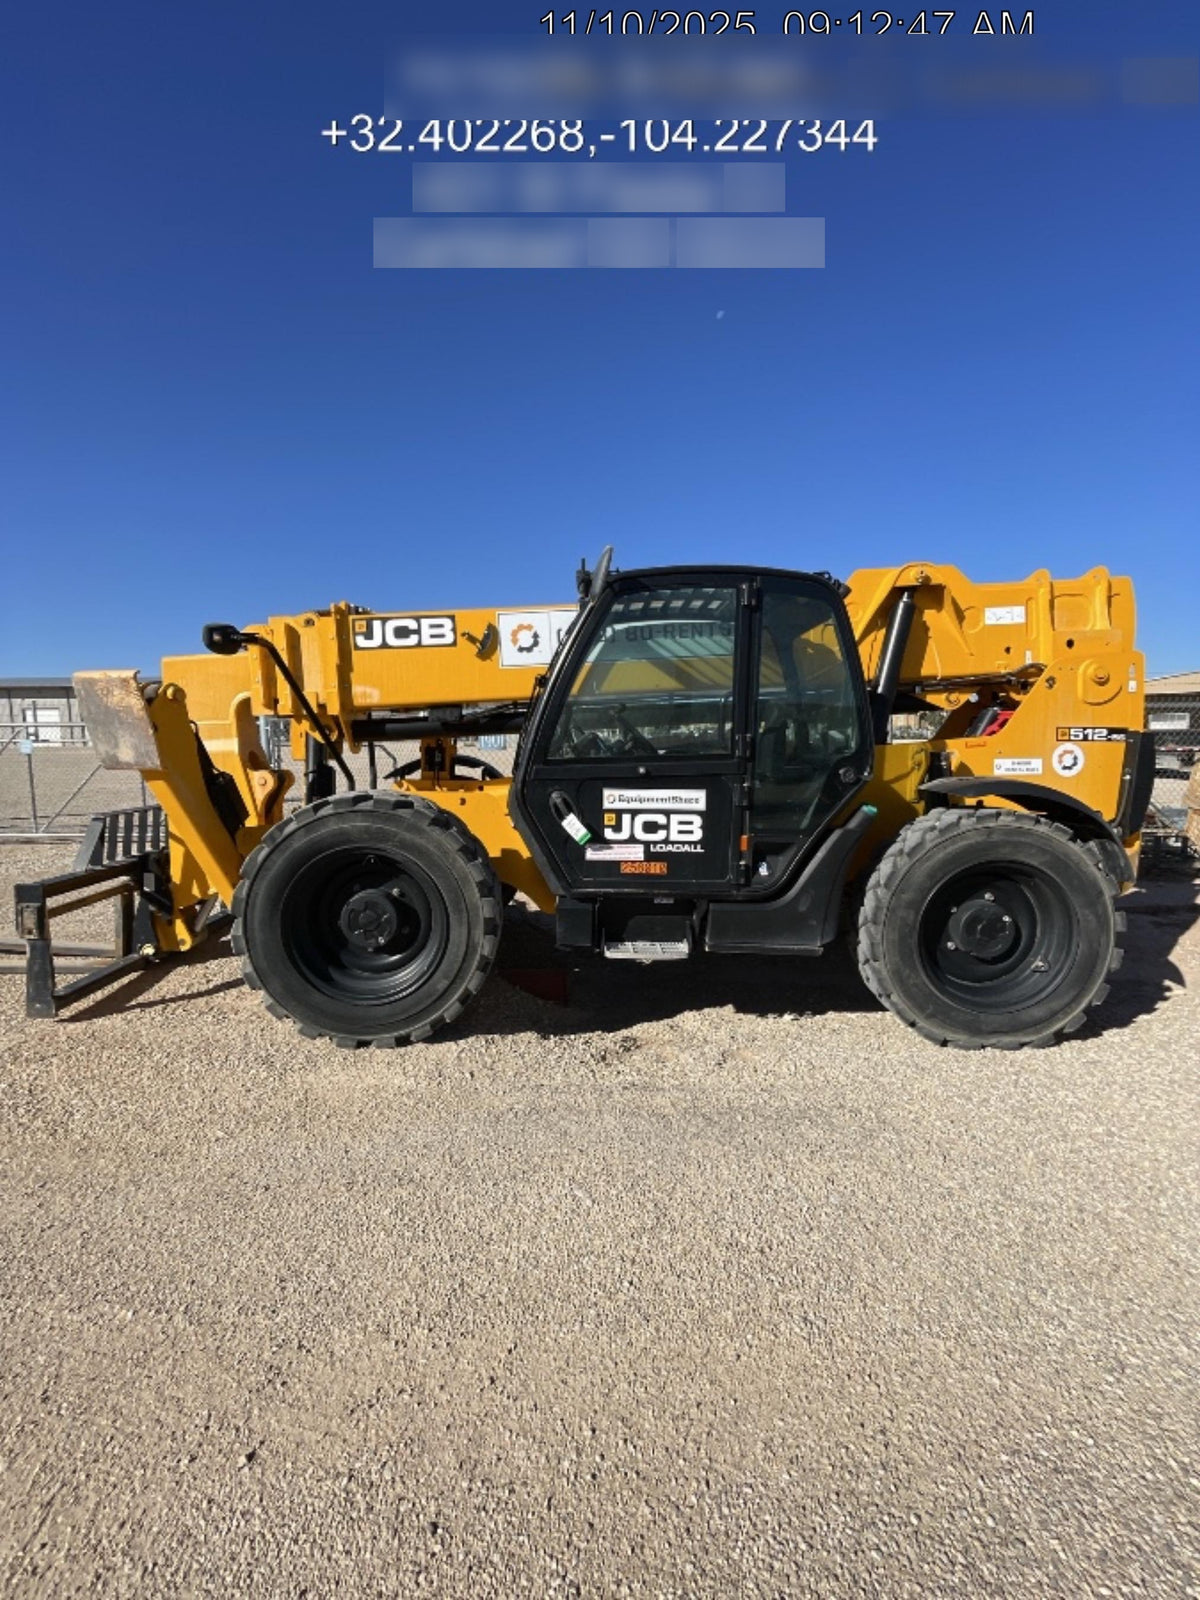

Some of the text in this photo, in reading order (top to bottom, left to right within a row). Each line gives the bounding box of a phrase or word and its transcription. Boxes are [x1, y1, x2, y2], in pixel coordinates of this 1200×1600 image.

[355, 617, 455, 648] JCB
[603, 813, 703, 841] JCB
[650, 843, 705, 852] LOADALL
